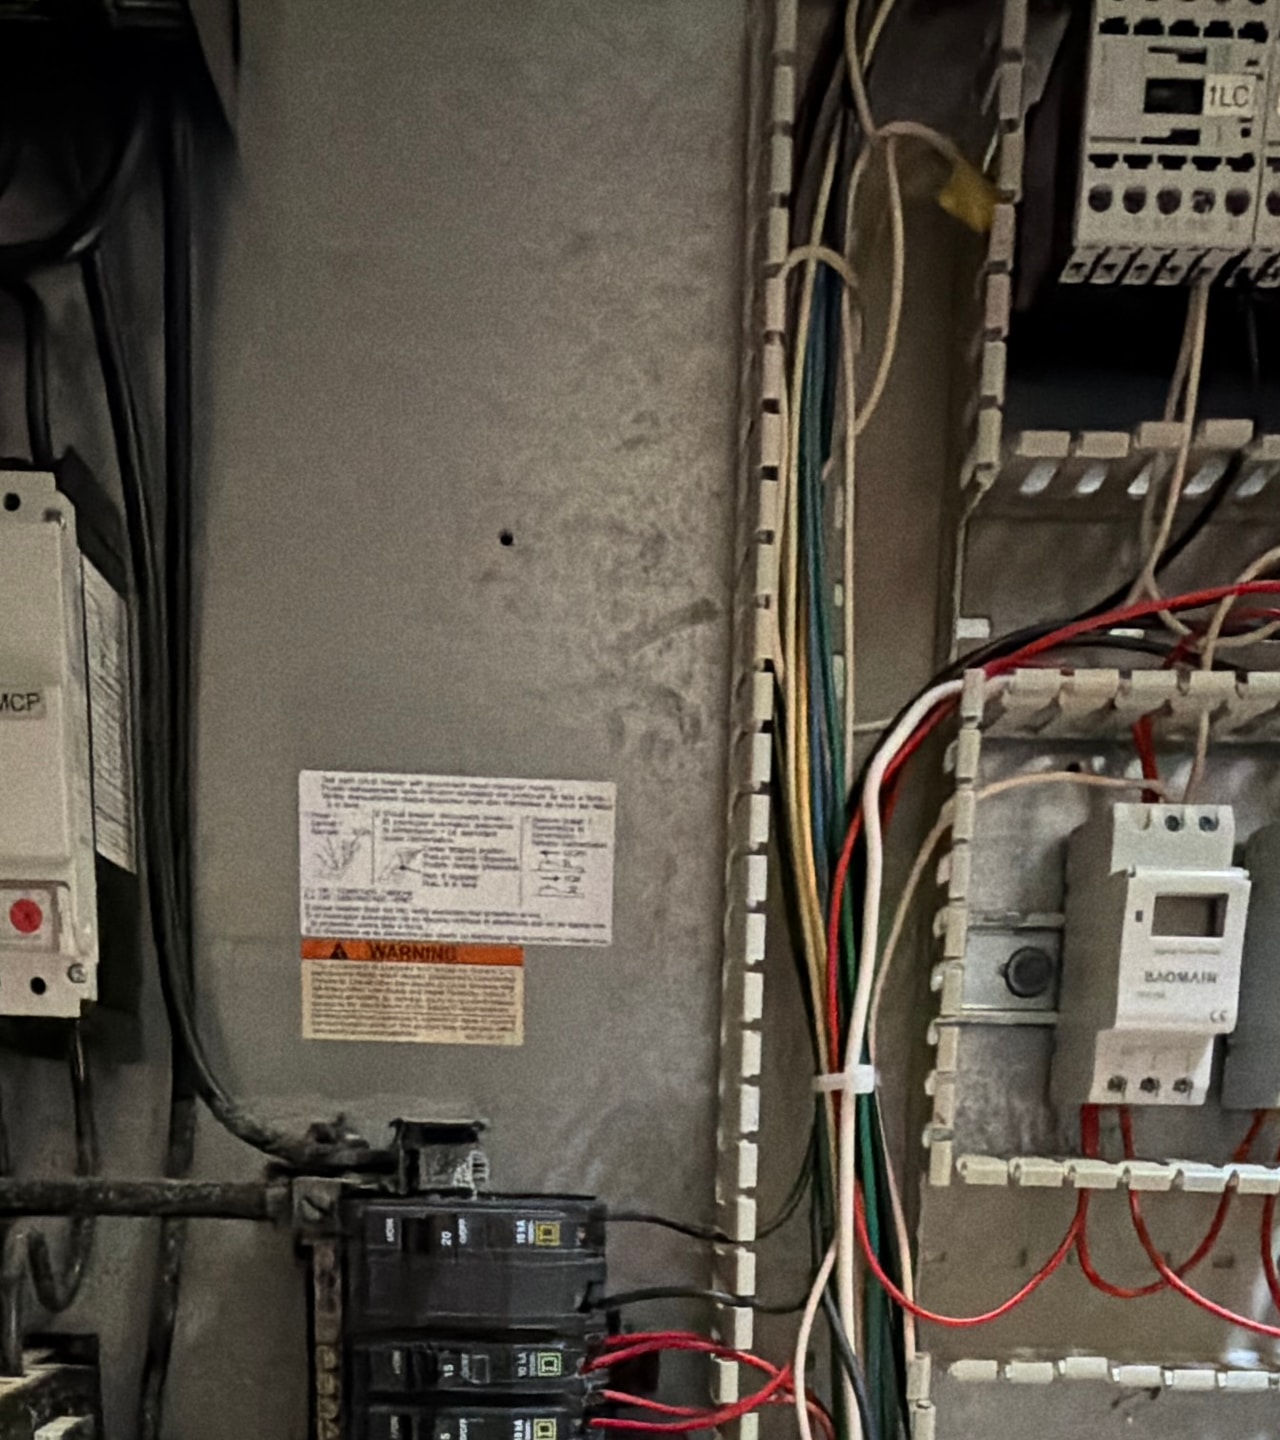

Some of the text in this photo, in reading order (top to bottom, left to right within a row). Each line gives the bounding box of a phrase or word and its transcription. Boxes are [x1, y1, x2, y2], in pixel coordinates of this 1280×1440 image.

[1208, 84, 1250, 108] 1LC
[369, 941, 458, 962] WARNING
[440, 1230, 452, 1246] 20
[443, 1363, 455, 1377] 15
